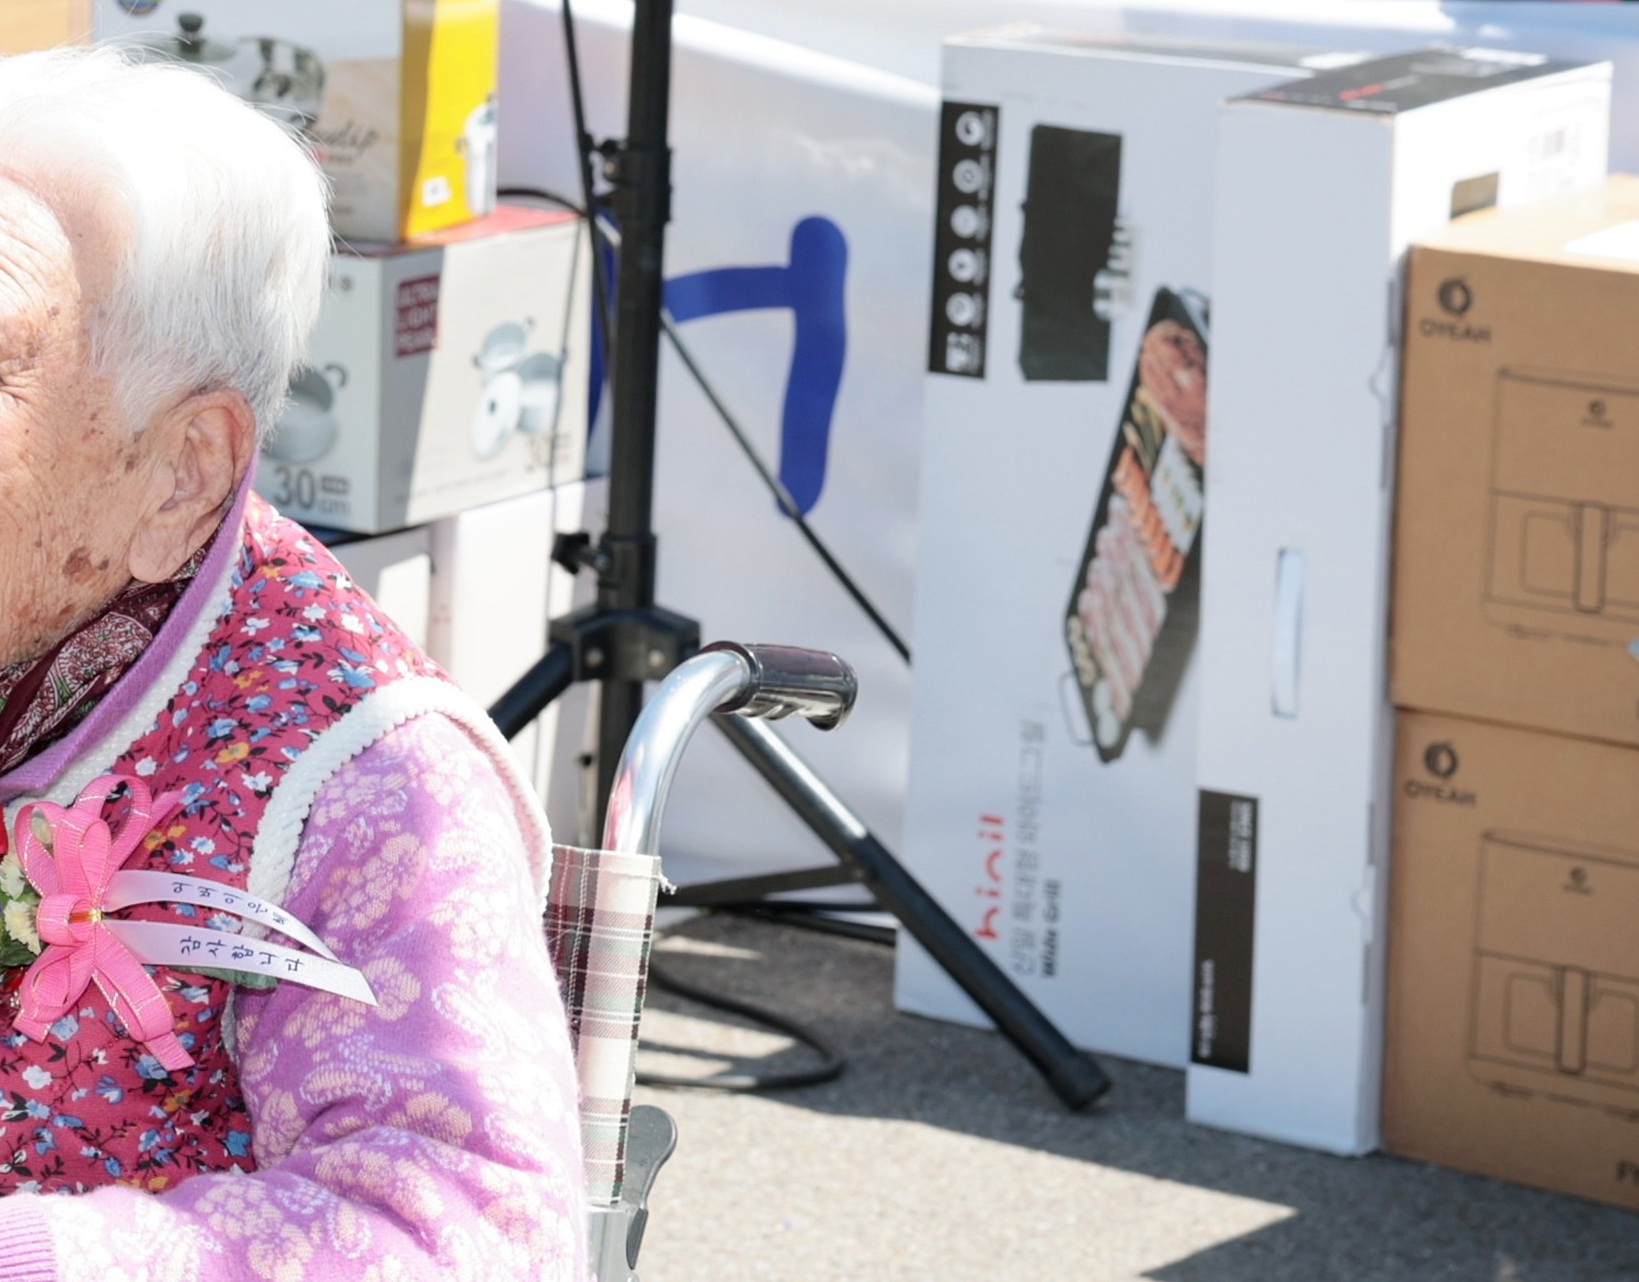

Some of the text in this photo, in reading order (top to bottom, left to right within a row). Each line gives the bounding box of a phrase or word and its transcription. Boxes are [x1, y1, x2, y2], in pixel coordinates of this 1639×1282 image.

[1419, 318, 1492, 343] OYEAH
[273, 465, 315, 509] 30
[1405, 781, 1476, 807] OYEAH
[179, 935, 304, 972] 감사합니다
